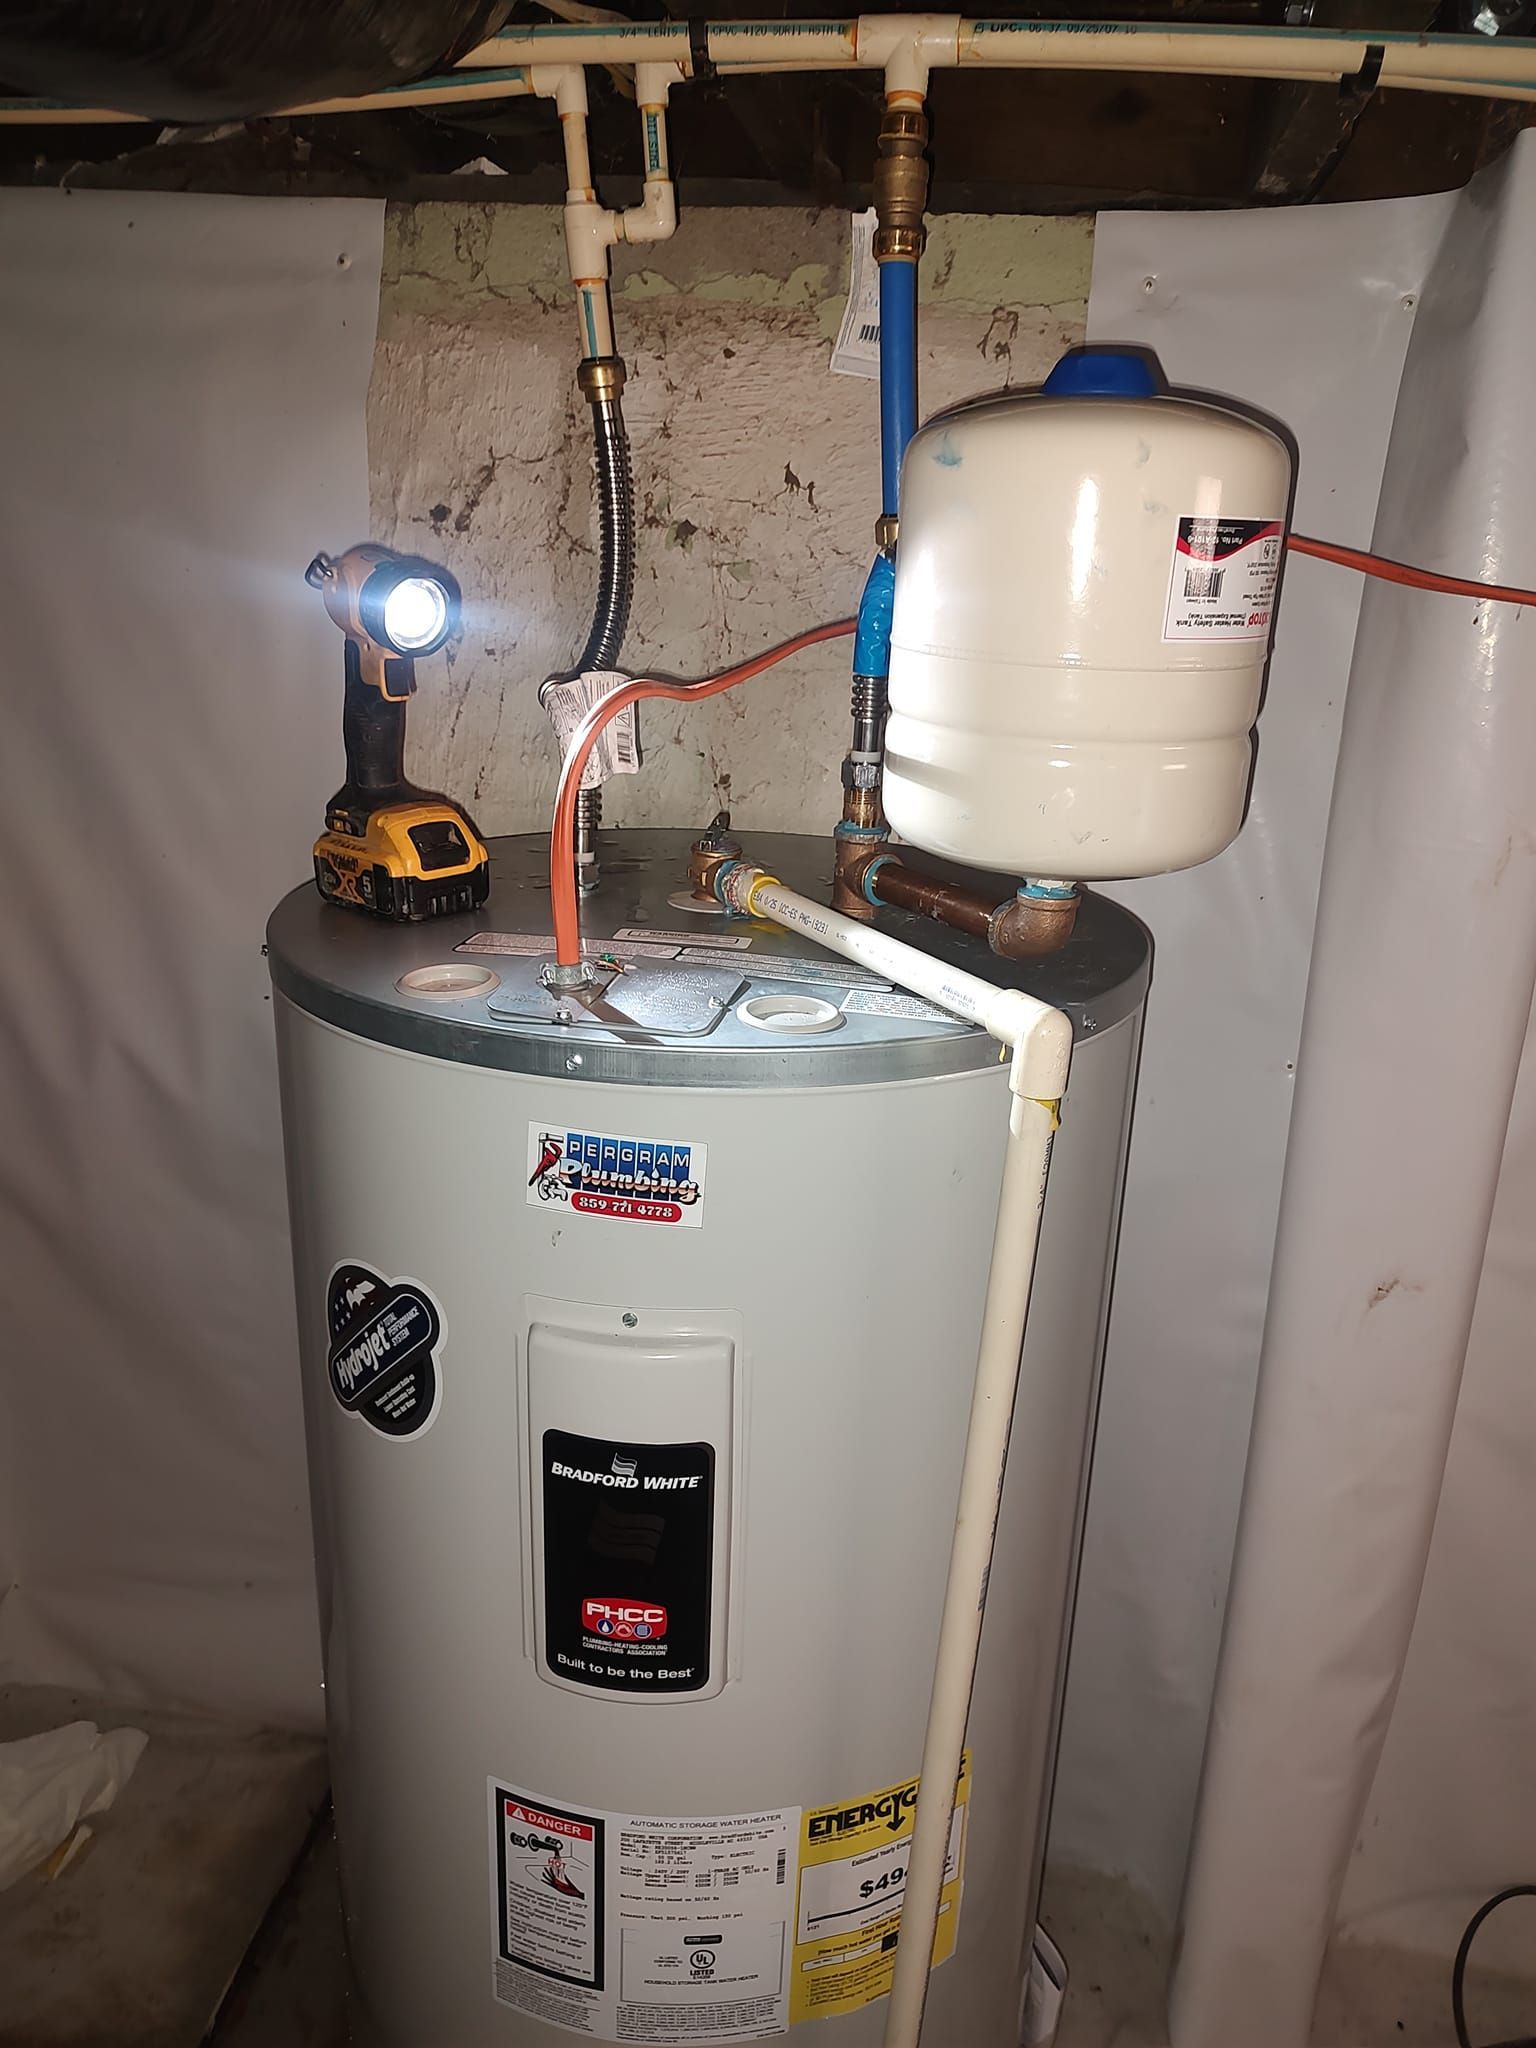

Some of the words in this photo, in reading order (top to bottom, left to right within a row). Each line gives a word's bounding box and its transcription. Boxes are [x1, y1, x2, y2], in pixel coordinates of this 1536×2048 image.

[569, 1141, 690, 1168] PERGRAM
[558, 1157, 702, 1206] Plumbing
[336, 1323, 391, 1390] Hydrojet
[551, 1461, 639, 1489] BRADFORD
[643, 1475, 703, 1490] WHITE
[586, 1601, 664, 1623] PHCC
[582, 1641, 624, 1655] CONTRACTORS
[627, 1647, 666, 1656] ASSOCIATION
[557, 1653, 586, 1670] Built
[588, 1662, 604, 1674] to
[607, 1666, 626, 1677] be
[629, 1669, 654, 1679] the
[657, 1668, 692, 1679] Best
[528, 1812, 581, 1836] DANGER
[630, 1820, 677, 1829] AUTOMATIC
[679, 1821, 718, 1829] STORAGE
[720, 1818, 748, 1827] WATER
[750, 1814, 781, 1825] HEATER
[548, 1857, 566, 1869] HOT
[851, 1853, 879, 1867] Estimated
[880, 1846, 896, 1857] Yearly
[859, 1867, 908, 1899] $49
[696, 1954, 709, 1966] UL
[690, 1968, 714, 1976] LISTED
